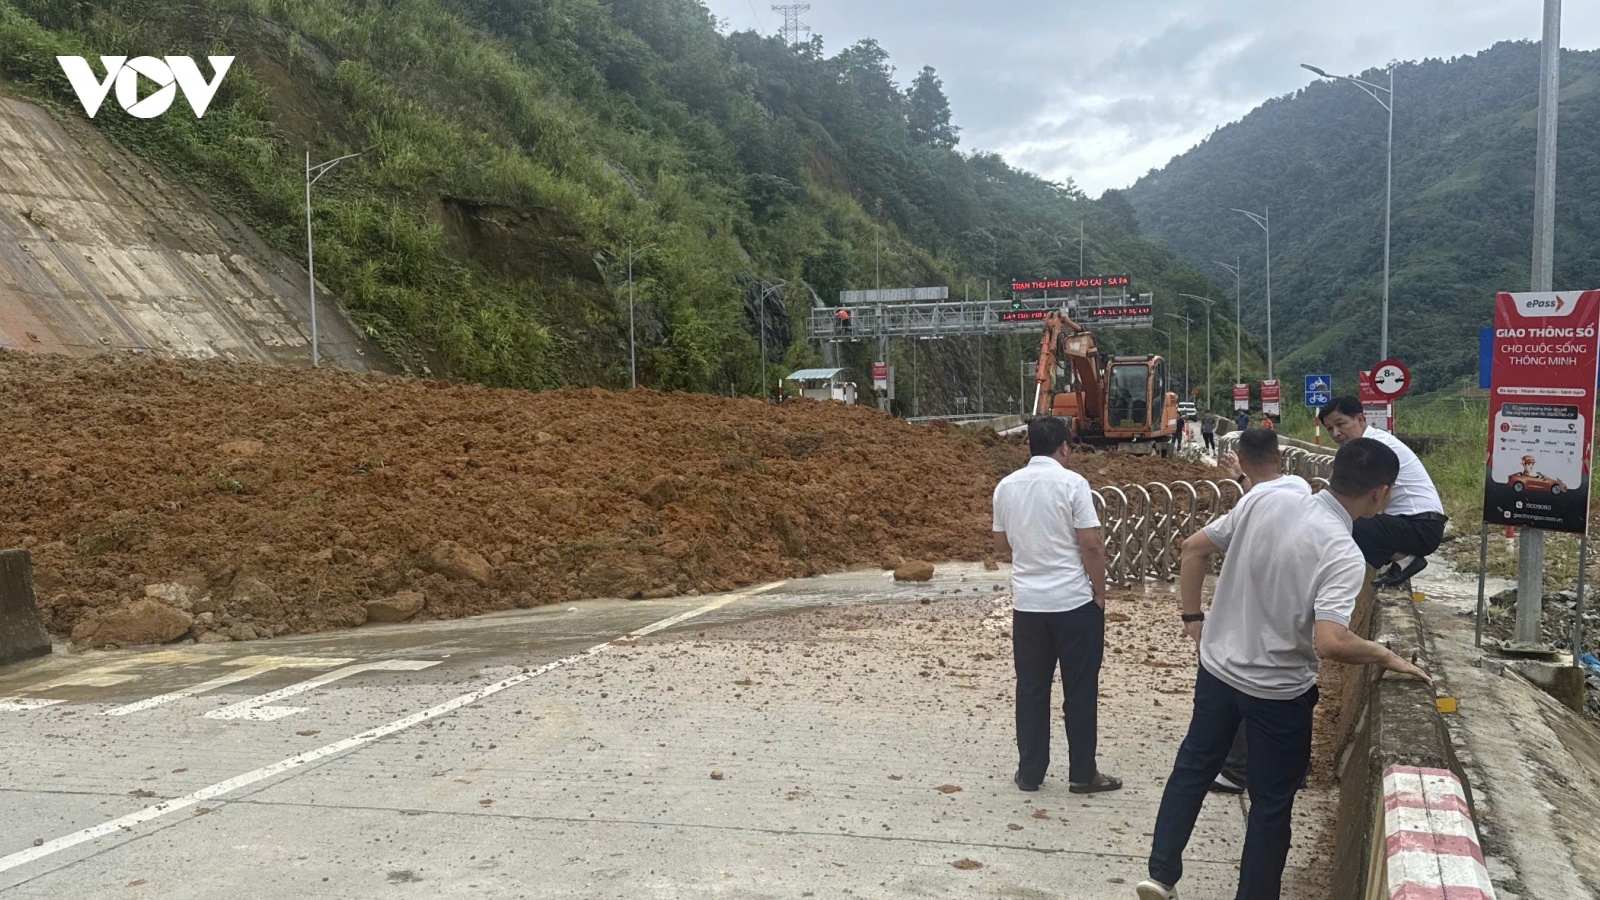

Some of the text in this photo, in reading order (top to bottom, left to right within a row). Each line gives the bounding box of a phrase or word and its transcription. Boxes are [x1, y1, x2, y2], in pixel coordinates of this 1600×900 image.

[1032, 281, 1045, 289] THU
[1526, 299, 1556, 308] ePass
[1496, 322, 1595, 338] GIAO THÔNG SỐ
[1501, 341, 1587, 354] CHO CUỘC SỐNG
[1509, 355, 1577, 366] THÔNG MINH
